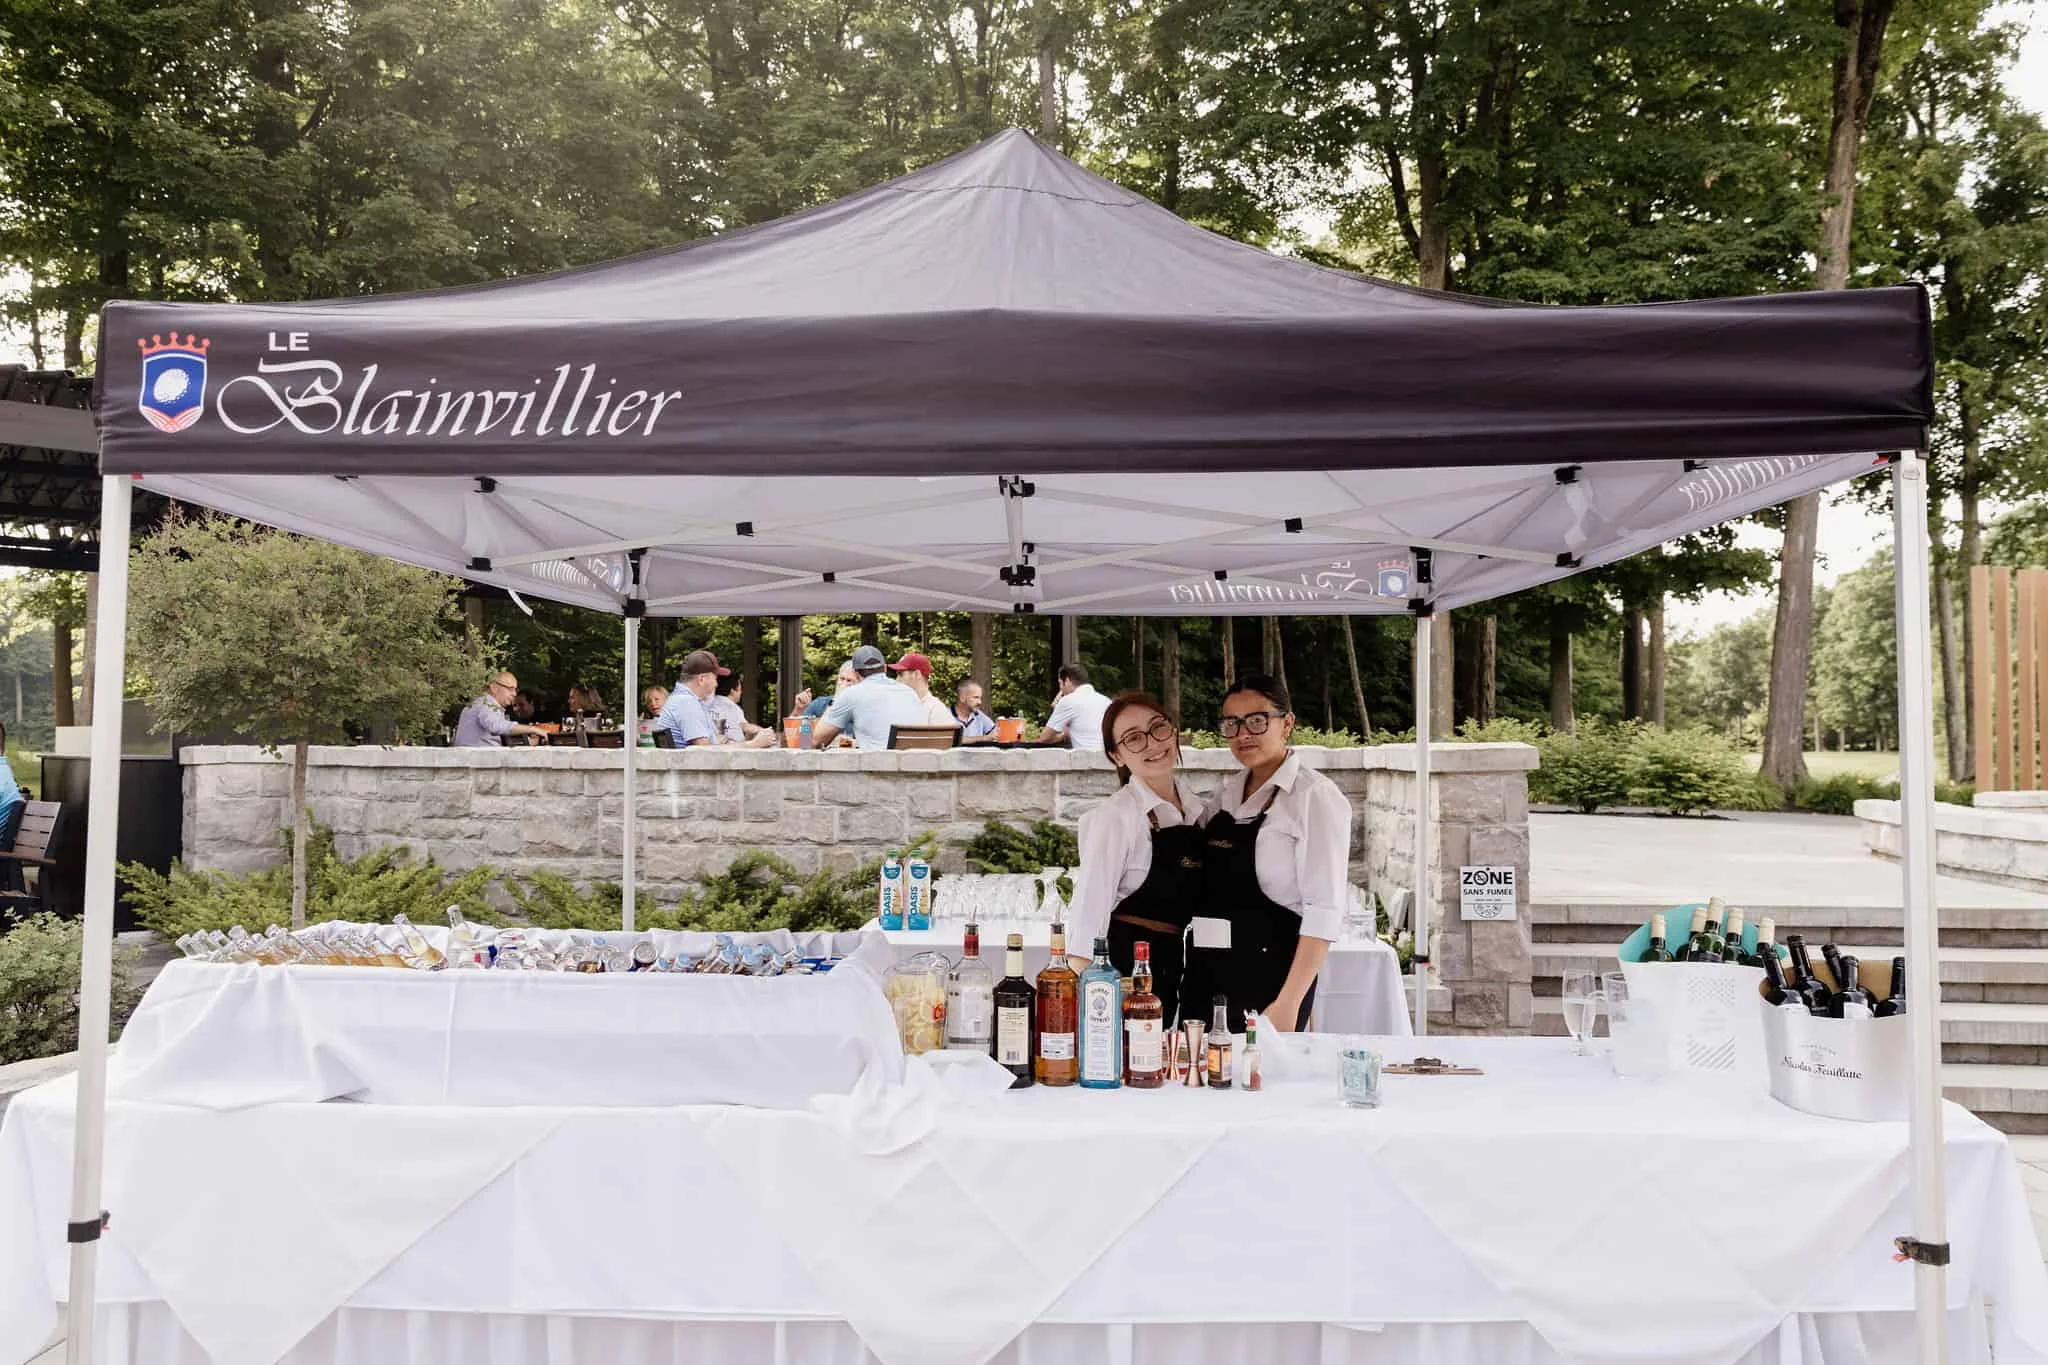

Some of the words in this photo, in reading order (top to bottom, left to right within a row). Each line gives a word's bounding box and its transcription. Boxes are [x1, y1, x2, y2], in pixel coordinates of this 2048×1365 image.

[268, 332, 310, 353] LE
[216, 358, 682, 437] Blainvillier
[1463, 888, 1484, 896] SANS
